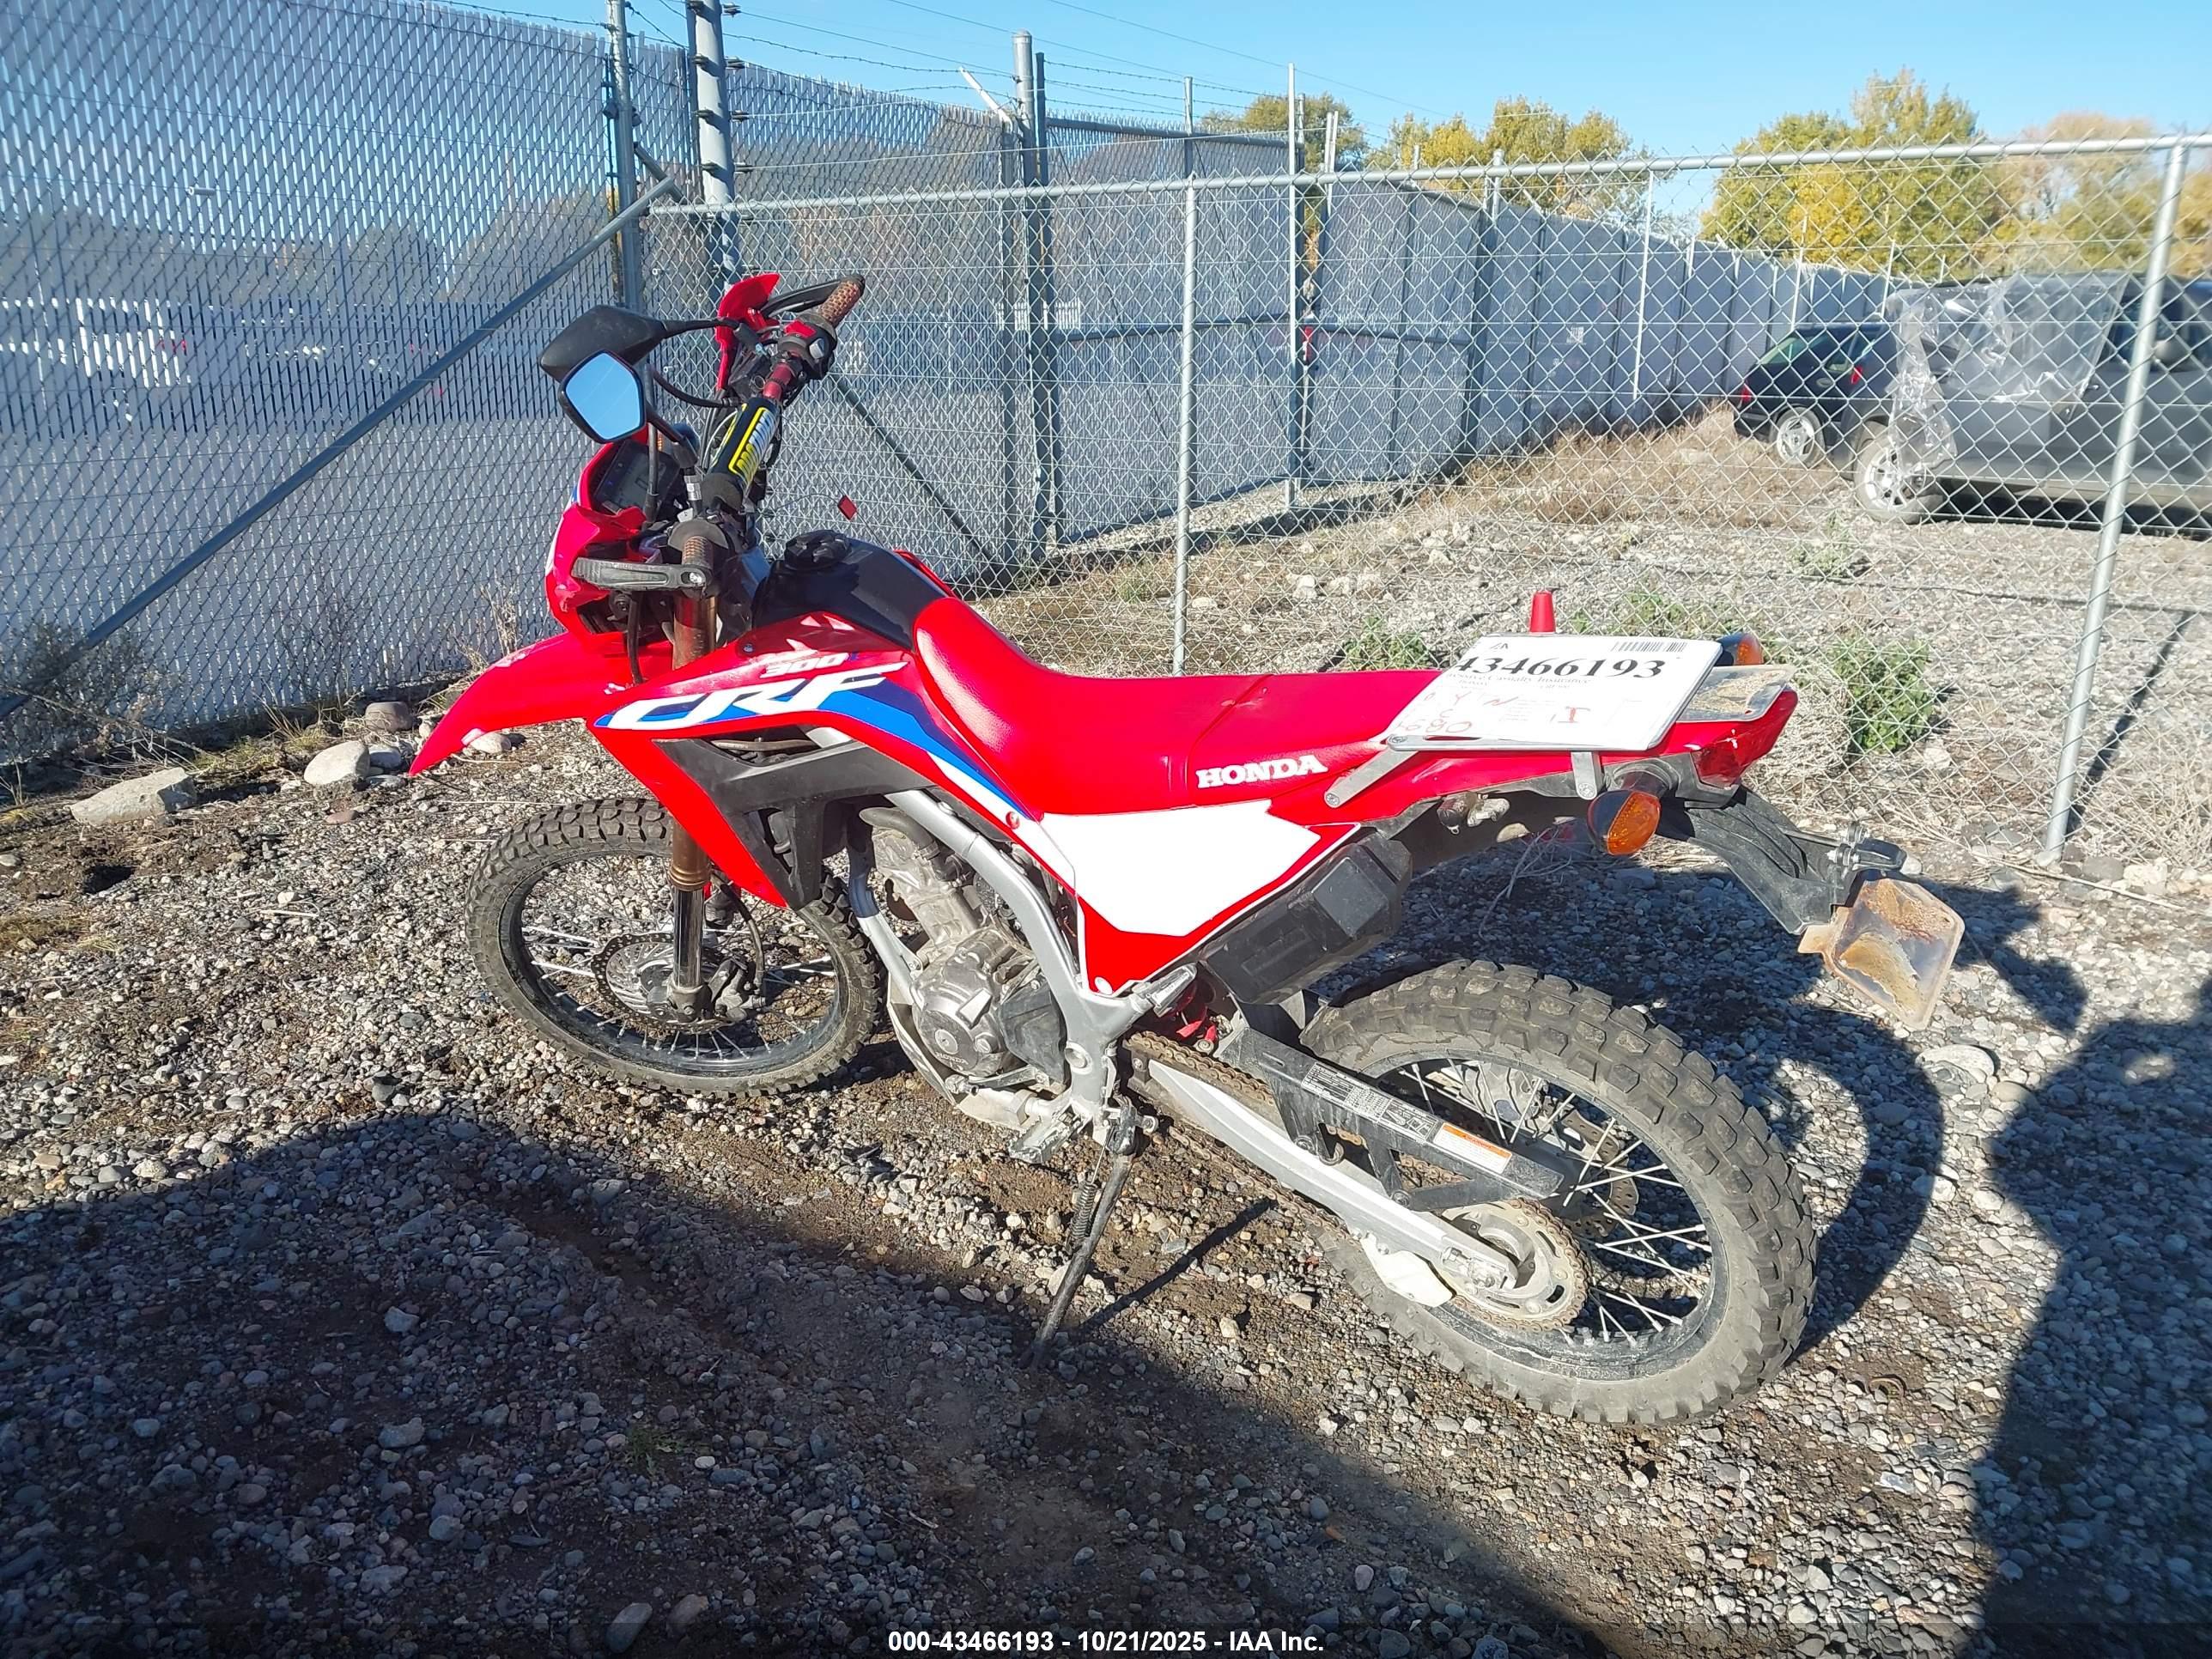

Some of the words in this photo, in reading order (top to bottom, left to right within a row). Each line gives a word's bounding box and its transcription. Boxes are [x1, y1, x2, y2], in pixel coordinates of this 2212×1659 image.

[759, 653, 850, 678] 300
[1453, 656, 1666, 678] 43466193
[607, 661, 910, 730] CRF
[1196, 755, 1328, 788] HONDA
